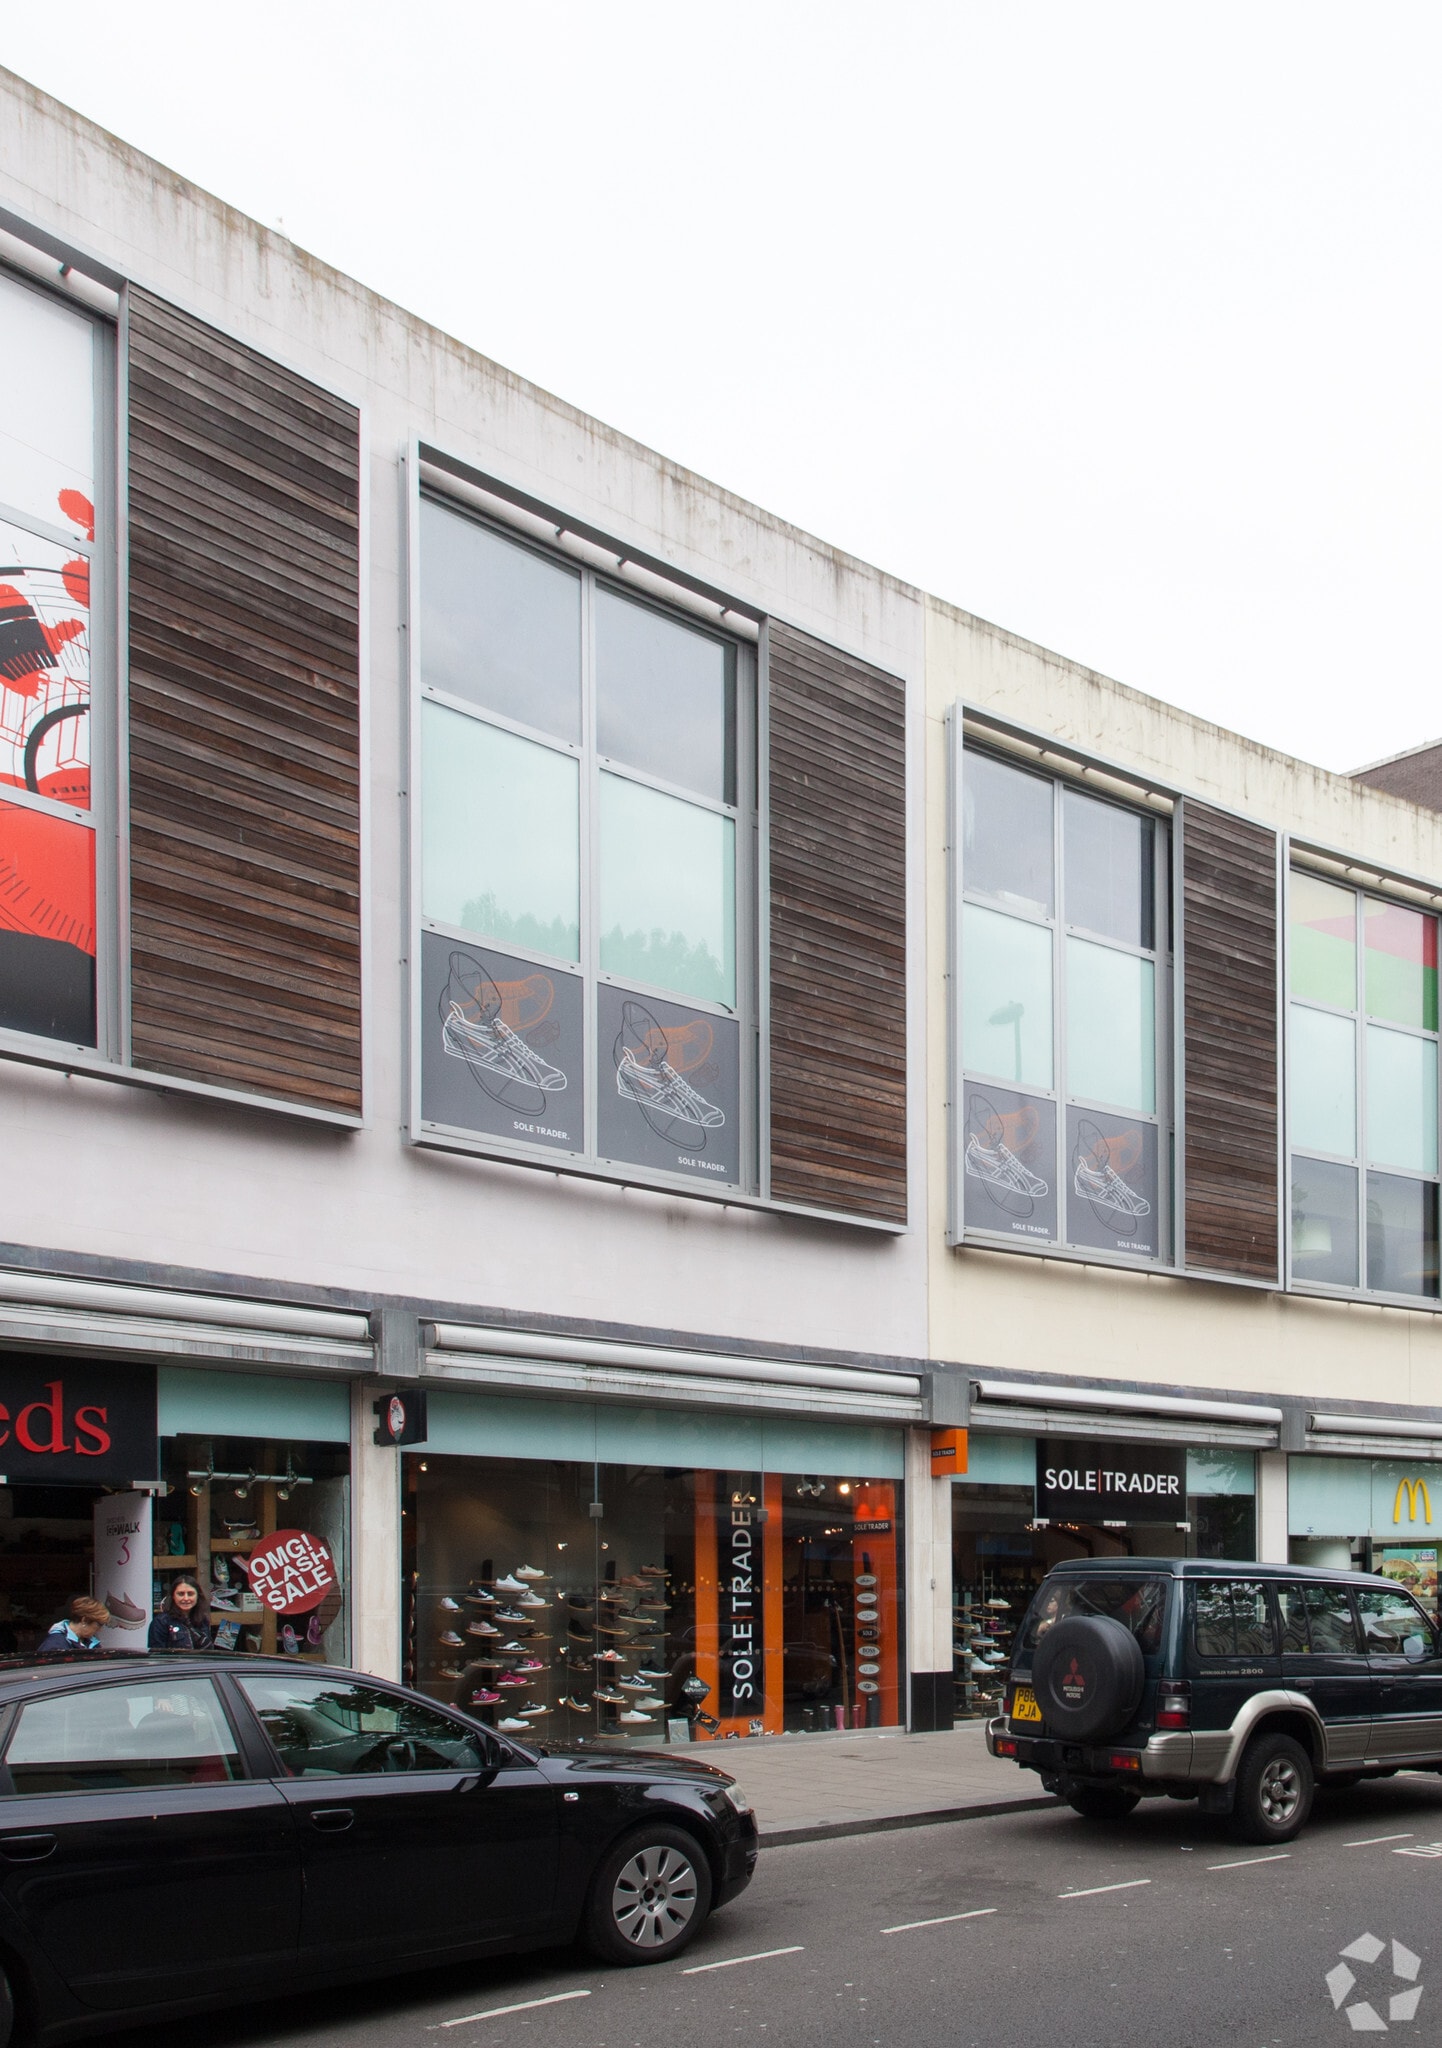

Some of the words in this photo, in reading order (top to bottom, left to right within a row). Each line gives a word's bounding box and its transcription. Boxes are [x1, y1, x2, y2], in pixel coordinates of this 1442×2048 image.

[513, 1121, 534, 1133] SOLE
[677, 1156, 697, 1167] SOLE
[1012, 1221, 1026, 1231] SOLE
[1117, 1240, 1131, 1249] SOLE
[0, 1379, 112, 1457] ds
[1044, 1468, 1097, 1491] SOLE
[1102, 1471, 1180, 1495] TRADER
[854, 1523, 868, 1531] SOLE
[868, 1522, 889, 1530] TRADER
[116, 1536, 130, 1566] 3
[250, 1533, 313, 1578] OMG!
[731, 1490, 752, 1613] TRADER
[252, 1546, 330, 1597] FLASH
[267, 1564, 332, 1611] SALE
[732, 1623, 753, 1699] SOLE
[1018, 1704, 1037, 1718] PJA
